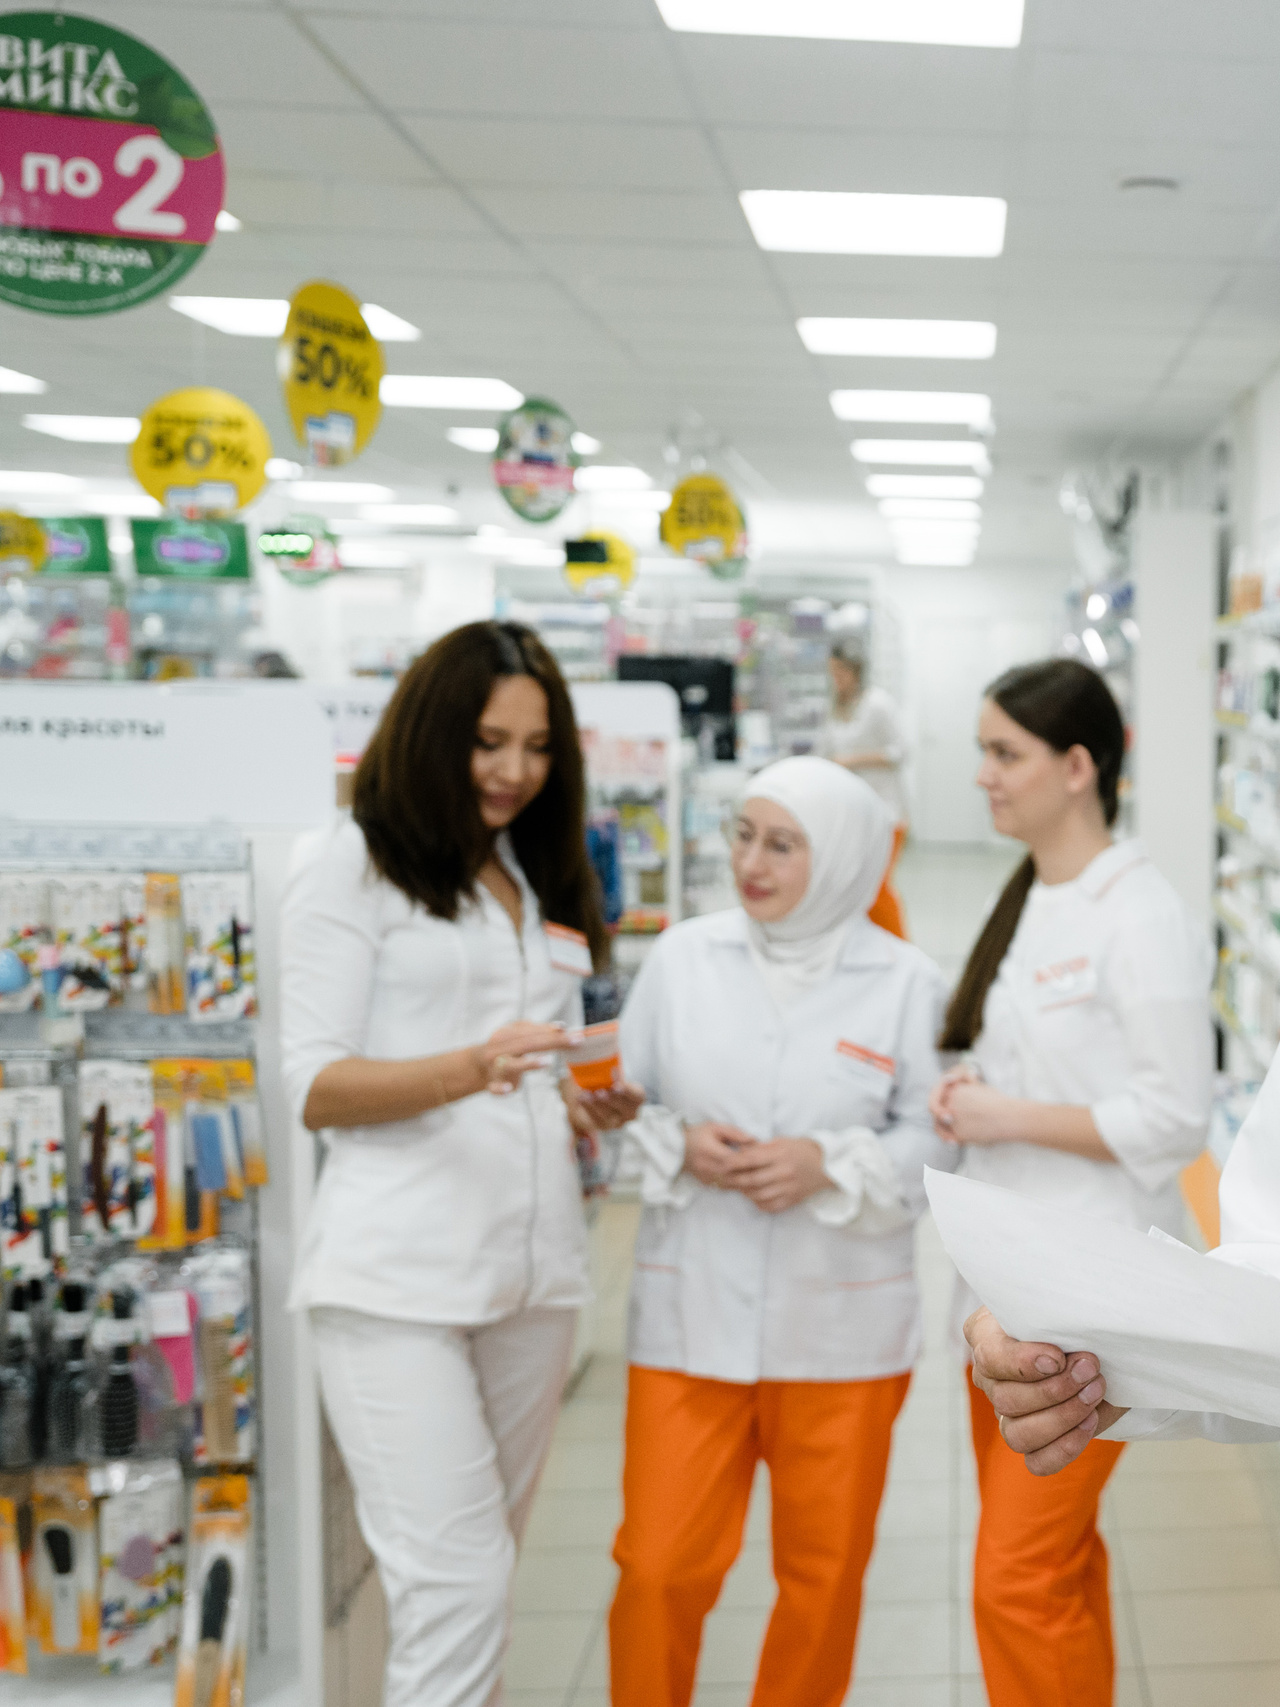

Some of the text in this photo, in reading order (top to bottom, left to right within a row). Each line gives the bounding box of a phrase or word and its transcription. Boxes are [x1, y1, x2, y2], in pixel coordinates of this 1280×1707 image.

[113, 134, 186, 236] 2
[296, 335, 371, 398] 50%
[150, 433, 250, 468] 50%
[41, 718, 165, 738] красоты
